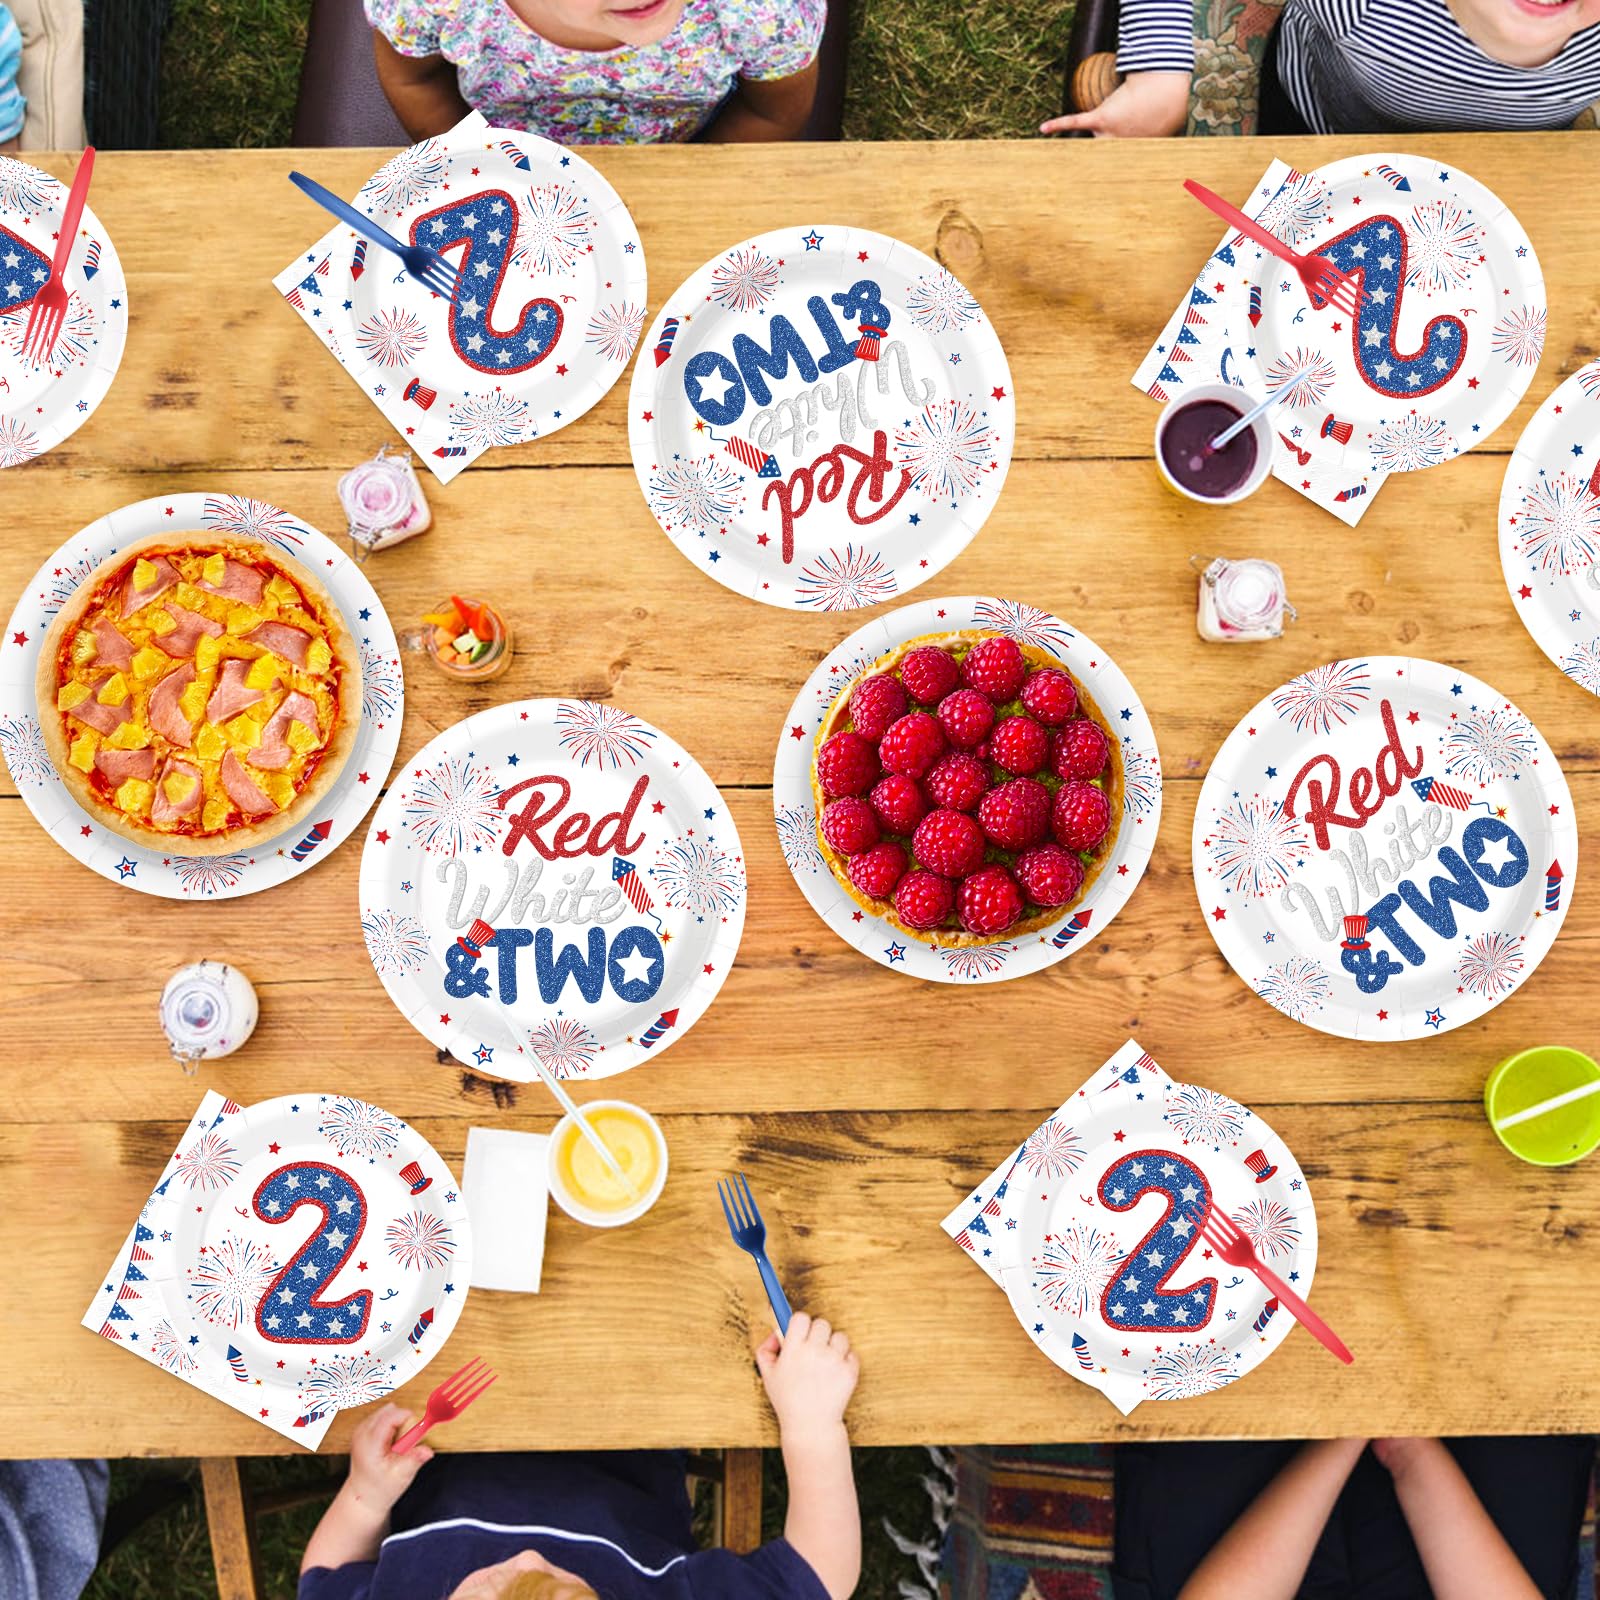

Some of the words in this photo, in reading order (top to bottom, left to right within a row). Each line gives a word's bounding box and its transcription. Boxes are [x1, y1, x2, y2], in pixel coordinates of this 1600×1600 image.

[409, 190, 564, 373] 2
[1306, 215, 1467, 398] 2
[750, 341, 936, 457] White
[763, 431, 912, 564] Red
[499, 774, 650, 860] Red
[1285, 699, 1423, 850] Red
[436, 857, 627, 929] White
[1281, 805, 1452, 941] White
[253, 1161, 373, 1344] 2
[1098, 1149, 1218, 1332] 2
